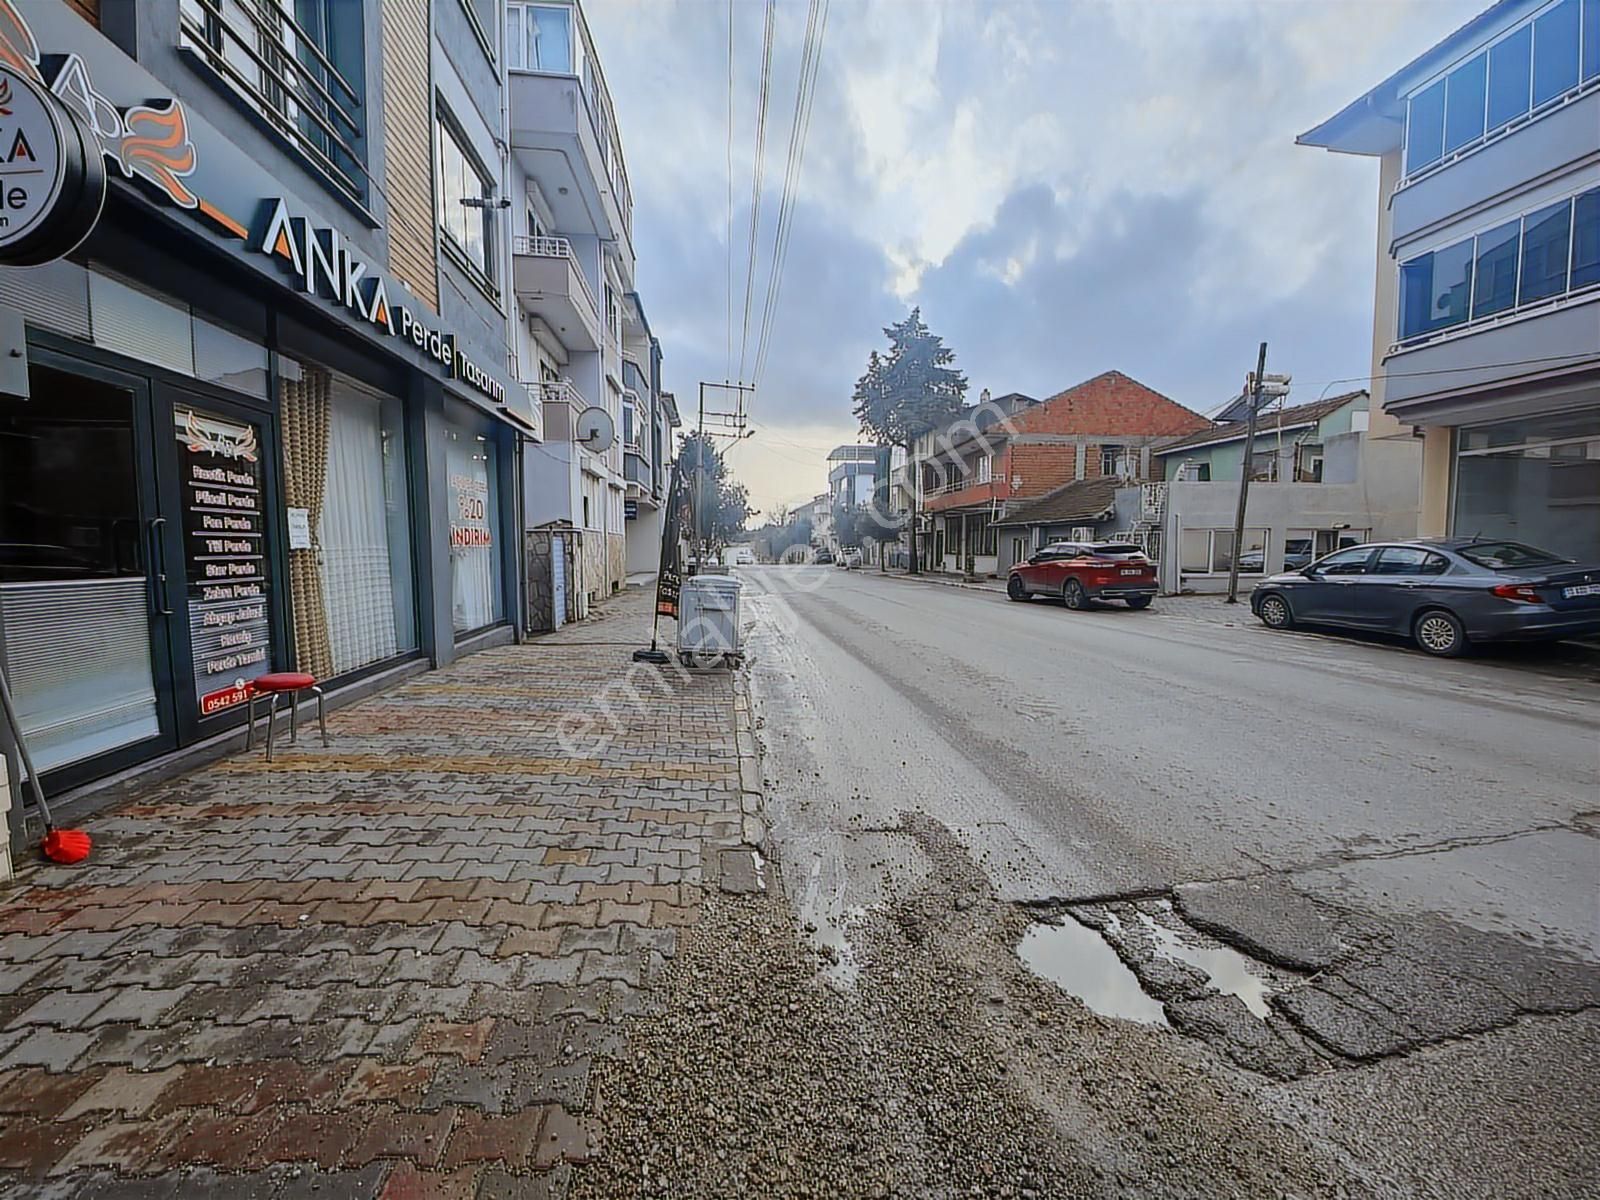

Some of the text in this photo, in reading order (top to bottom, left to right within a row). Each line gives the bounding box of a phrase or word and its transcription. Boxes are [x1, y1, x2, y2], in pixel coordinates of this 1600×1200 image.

[261, 197, 506, 405] ANKA Perde Tasarım
